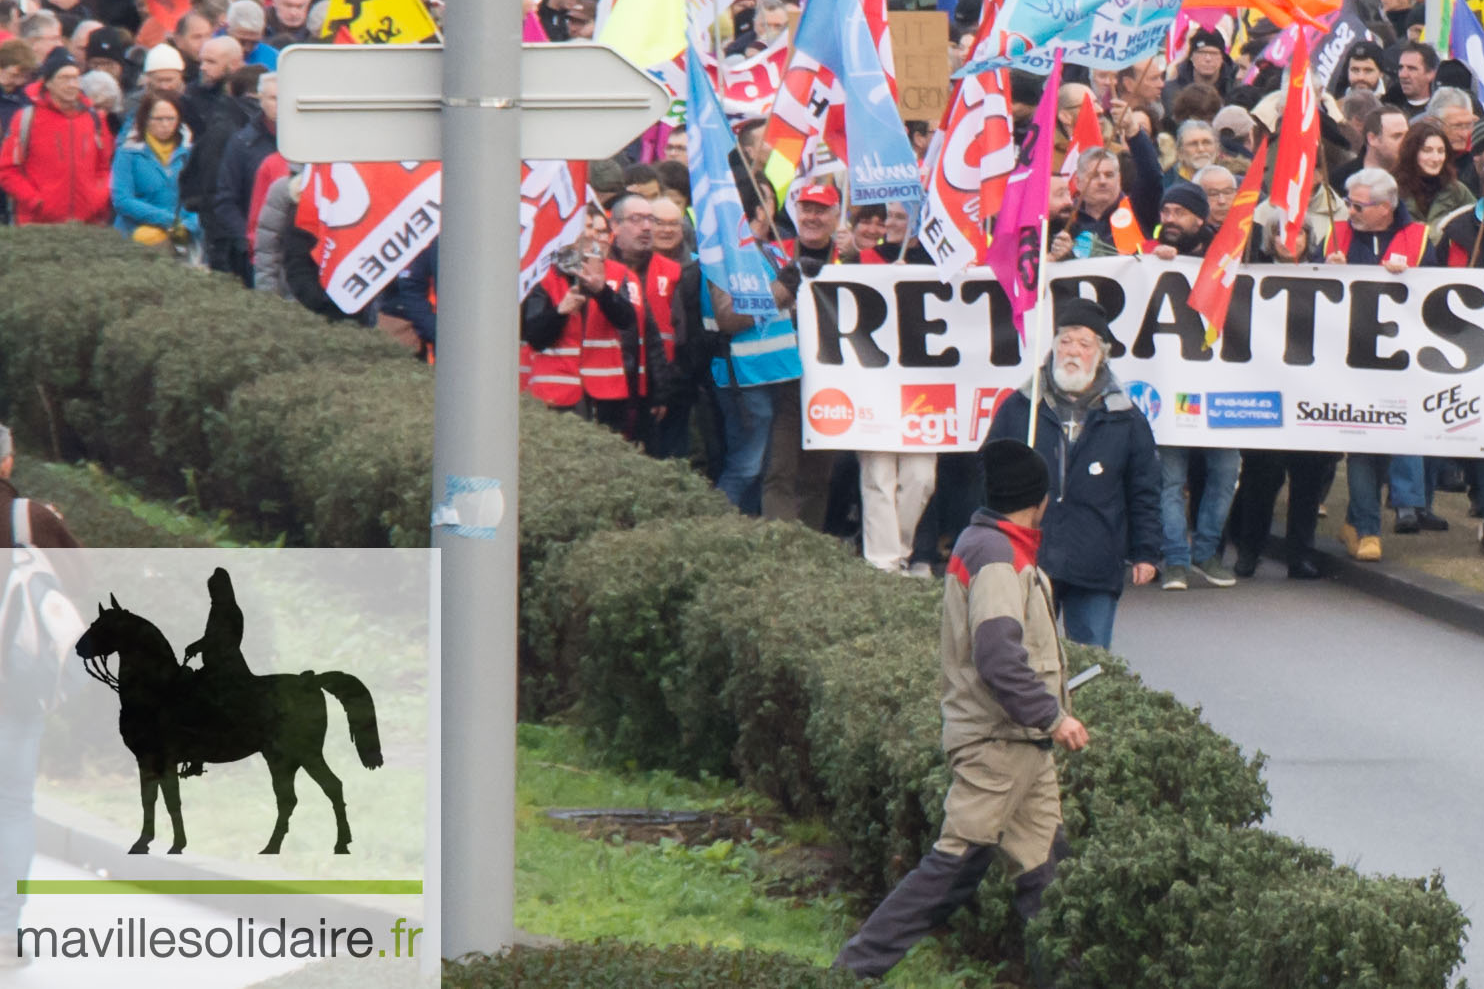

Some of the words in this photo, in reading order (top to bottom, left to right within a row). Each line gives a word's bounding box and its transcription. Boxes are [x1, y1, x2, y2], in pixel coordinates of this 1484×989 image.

[1422, 384, 1462, 413] CFE
[1441, 396, 1481, 425] CGC
[900, 407, 958, 444] cgt
[1296, 401, 1408, 426] Solidaires
